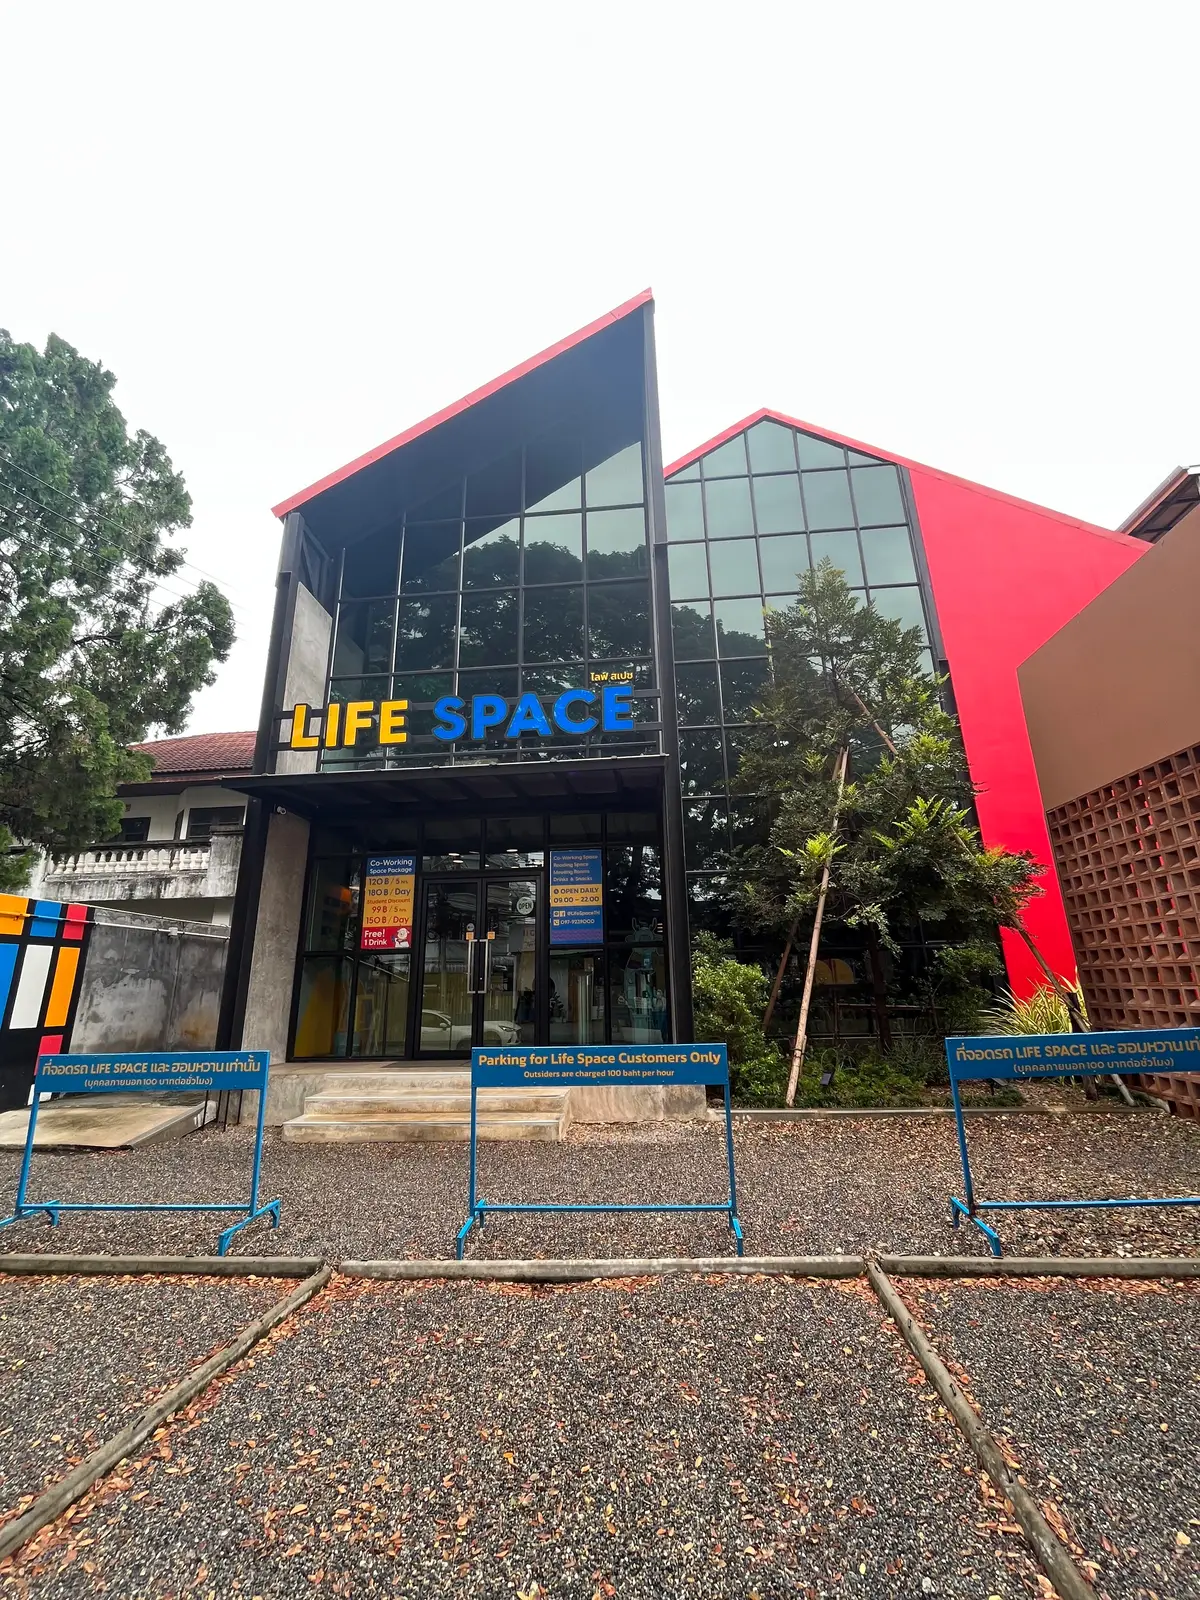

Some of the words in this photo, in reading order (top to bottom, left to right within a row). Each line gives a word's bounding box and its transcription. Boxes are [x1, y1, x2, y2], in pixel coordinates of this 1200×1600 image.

[291, 700, 409, 748] LIFE
[433, 685, 634, 741] SPACE
[370, 858, 412, 866] Co-Working
[395, 888, 411, 896] Day
[393, 916, 409, 924] Day
[364, 929, 385, 938] Free!
[956, 1042, 1013, 1060] ที่จอดรถ
[1016, 1046, 1041, 1058] LIFE
[1045, 1044, 1088, 1057] SPACE
[1091, 1044, 1115, 1055] และ
[478, 1054, 526, 1067] Parking
[530, 1054, 548, 1064] for
[551, 1053, 574, 1064] Life
[577, 1053, 615, 1066] Space
[618, 1052, 687, 1063] Customers
[690, 1052, 721, 1065] Only
[42, 1059, 88, 1075] ที่จอดรถ
[91, 1063, 111, 1074] LIFE
[114, 1062, 148, 1073] SPACE
[150, 1063, 169, 1073] และ
[575, 1070, 606, 1079] charged
